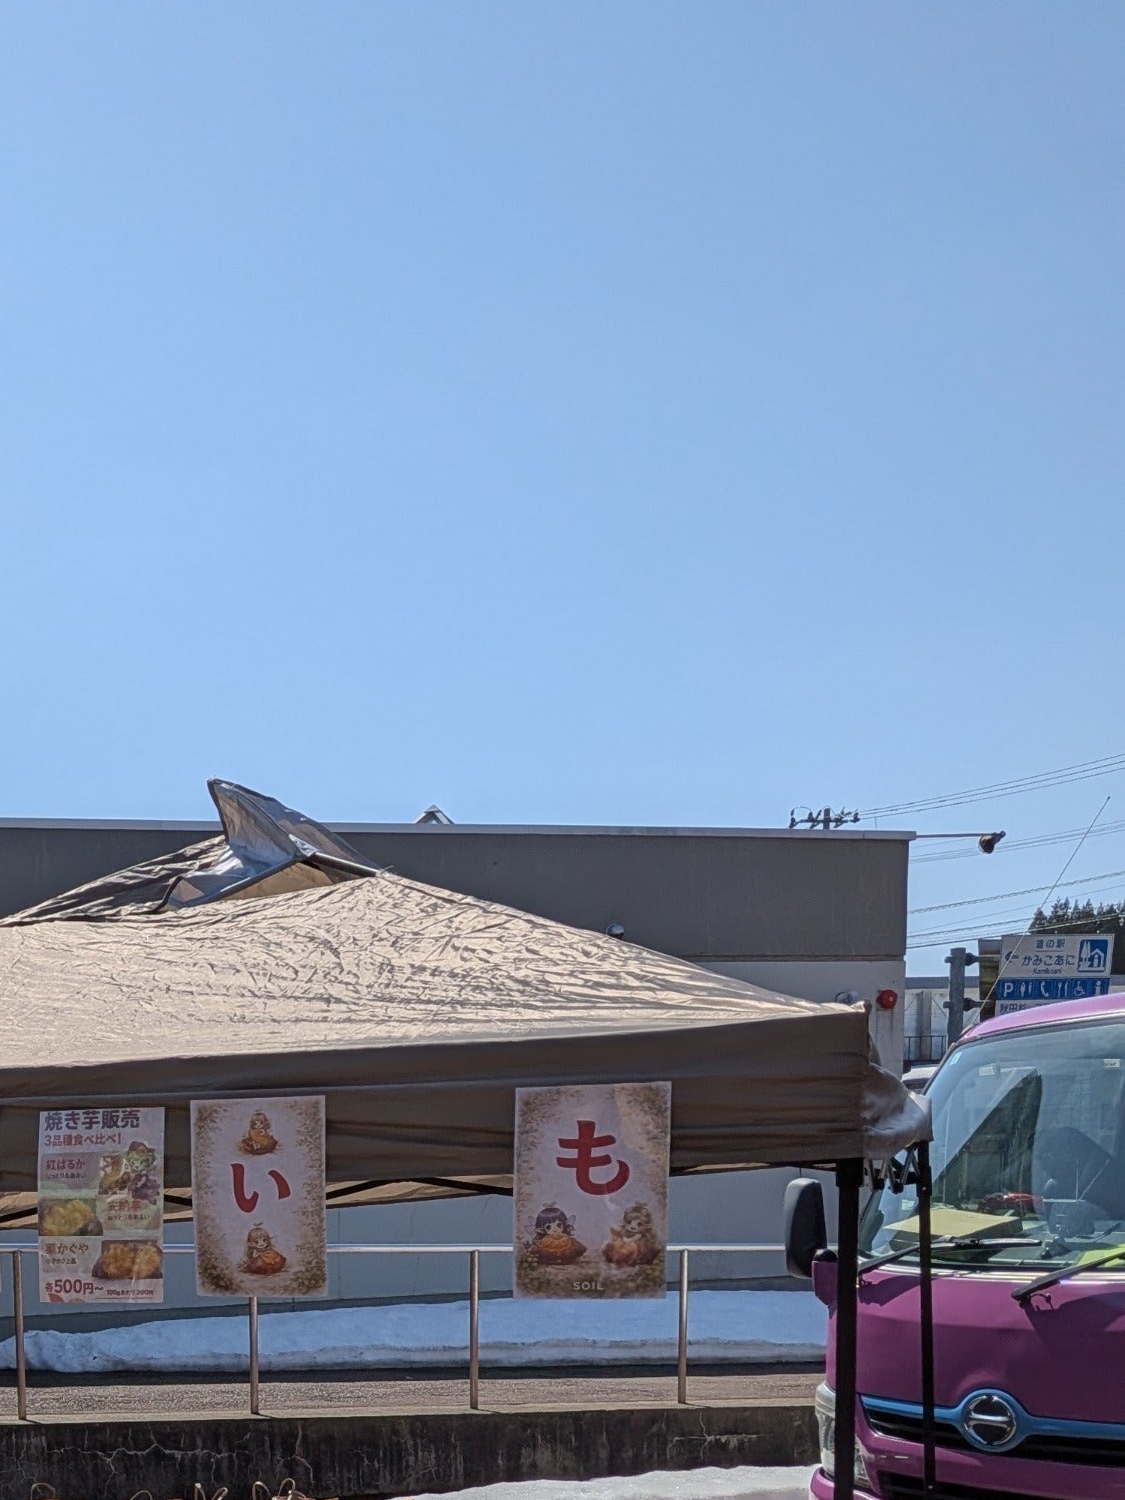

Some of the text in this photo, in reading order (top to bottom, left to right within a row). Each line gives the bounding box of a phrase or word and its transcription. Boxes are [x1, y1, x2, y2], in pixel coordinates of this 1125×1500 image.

[1035, 938, 1066, 949] 道の駅
[1021, 954, 1076, 967] かみこあに
[44, 1109, 140, 1131] 焼き芋販売
[556, 1119, 631, 1196] も
[45, 1158, 86, 1171] 紅はるか
[231, 1162, 291, 1214] い
[45, 1242, 89, 1255] 栗かぐや
[573, 1281, 604, 1290] SOIL
